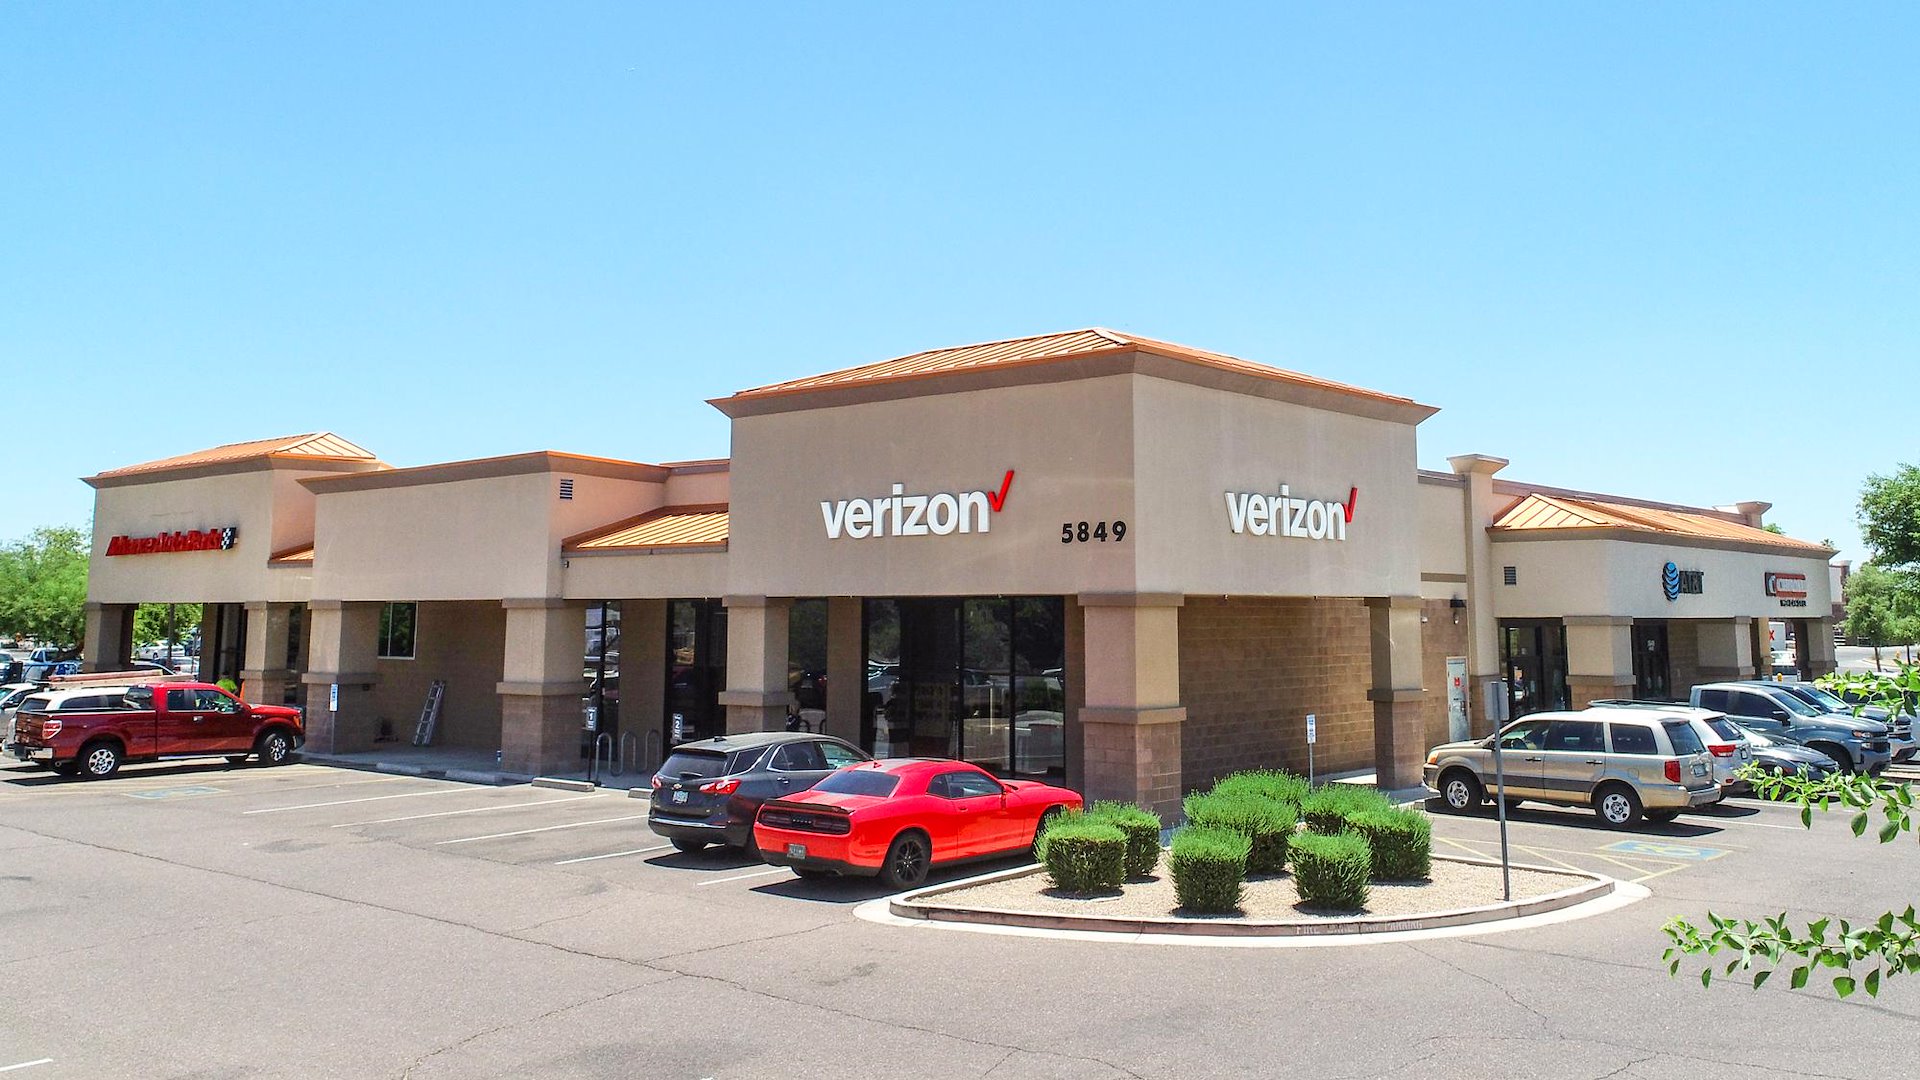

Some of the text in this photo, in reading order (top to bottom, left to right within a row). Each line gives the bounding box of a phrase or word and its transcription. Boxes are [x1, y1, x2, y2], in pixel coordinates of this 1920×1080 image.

[820, 482, 991, 539] verizon
[1224, 484, 1346, 540] verizon
[1061, 520, 1127, 543] 5849
[1678, 570, 1704, 594] AT&T
